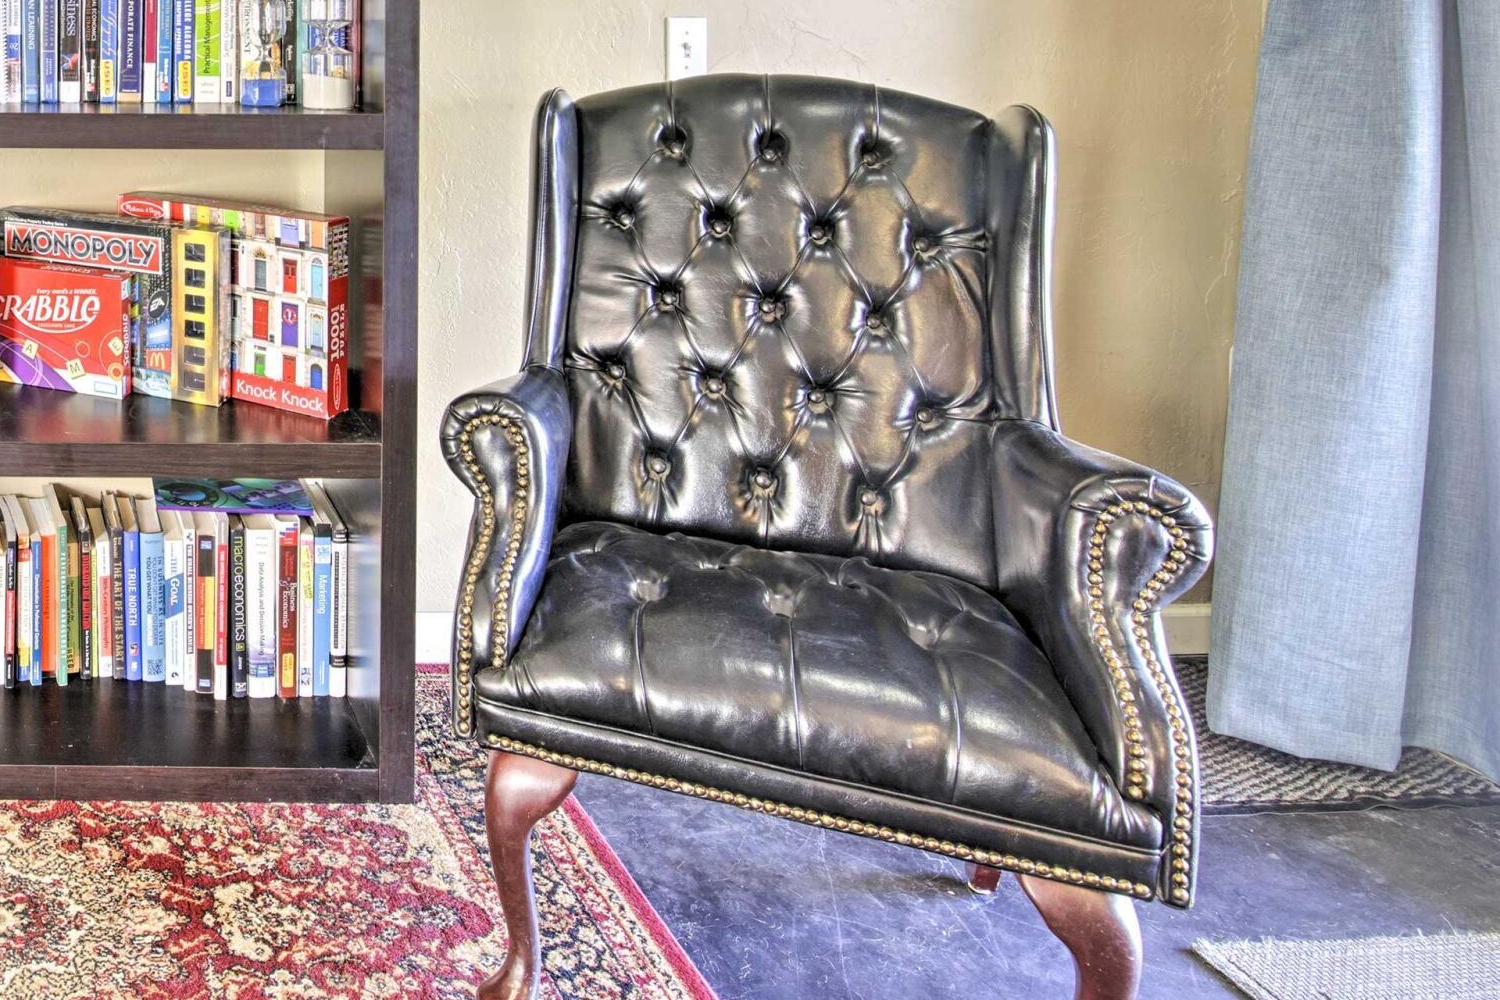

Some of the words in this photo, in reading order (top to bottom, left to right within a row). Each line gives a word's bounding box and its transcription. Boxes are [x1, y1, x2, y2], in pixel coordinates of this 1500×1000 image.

[203, 0, 212, 43] Management
[203, 45, 211, 73] Practical
[10, 225, 156, 268] MONOPOLY
[25, 343, 34, 354] A
[69, 361, 81, 374] M
[236, 378, 277, 401] Knock
[281, 390, 324, 413] Knock
[113, 562, 122, 579] THE
[128, 568, 137, 592] TRUE
[114, 581, 123, 598] ART
[170, 578, 180, 606] GOAL
[234, 536, 245, 641] macroeconomics
[257, 576, 265, 598] Analysis
[316, 574, 328, 615] Marketing
[114, 600, 123, 611] OF
[128, 595, 137, 626] NORTH
[158, 607, 163, 616] AS
[102, 616, 110, 648] Philosophy
[115, 614, 123, 632] THE
[115, 634, 124, 661] START
